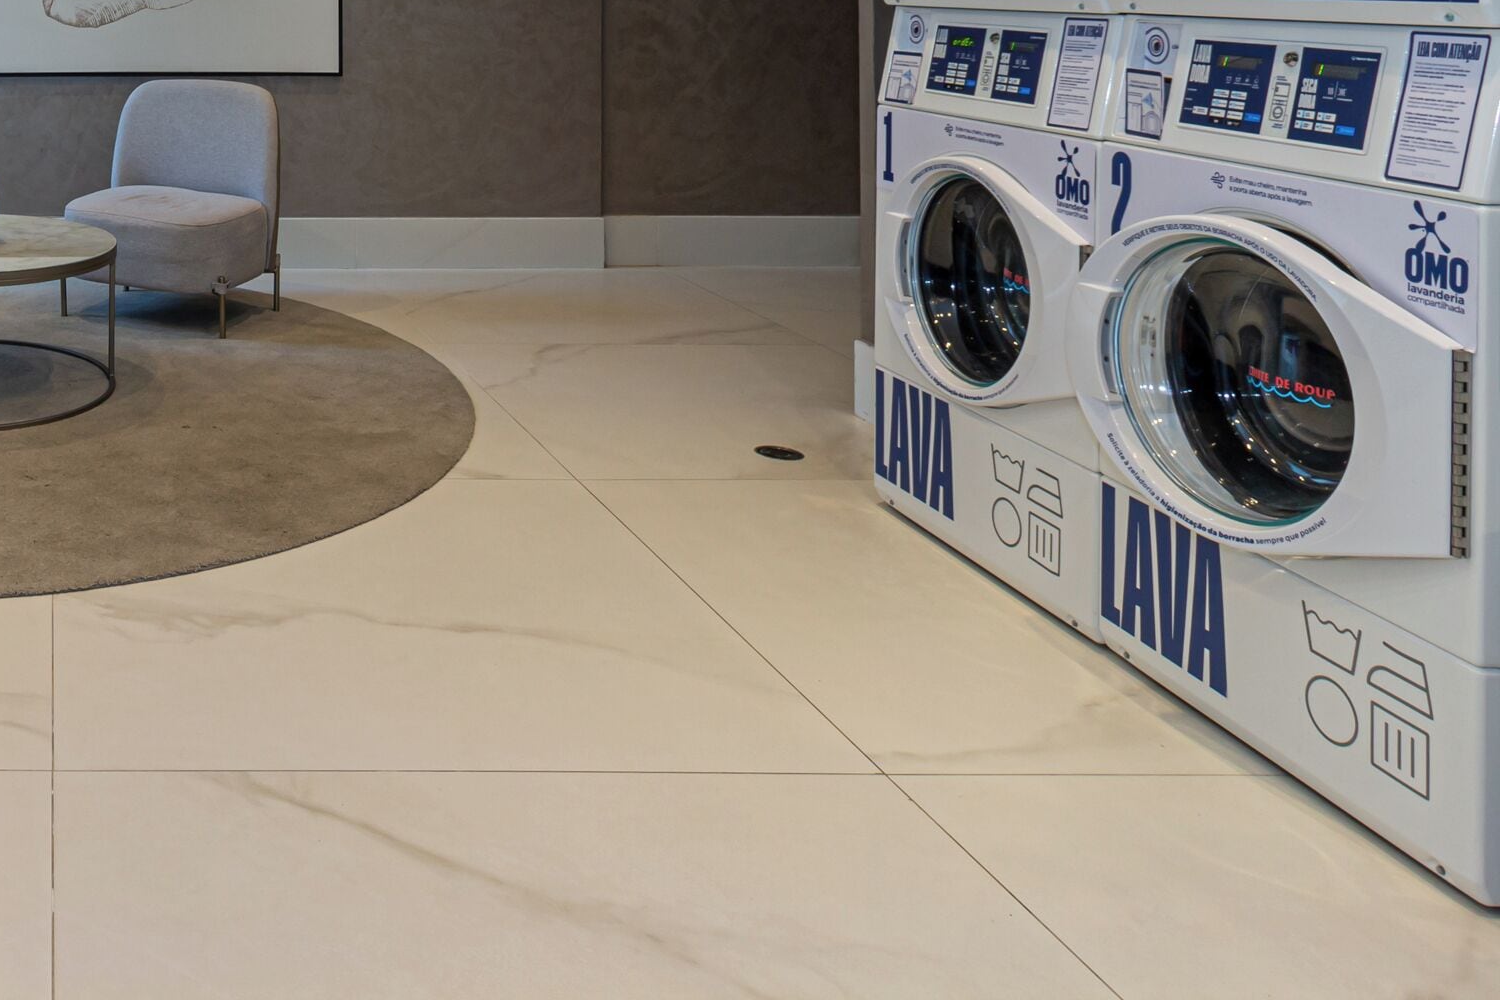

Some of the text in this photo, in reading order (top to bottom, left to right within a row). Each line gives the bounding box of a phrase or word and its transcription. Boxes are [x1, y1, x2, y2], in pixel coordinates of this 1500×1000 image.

[883, 112, 894, 182] 1
[1055, 174, 1090, 205] OMO
[1111, 151, 1132, 236] 2
[1405, 248, 1469, 294] OMO
[1407, 282, 1465, 305] lavanderia
[1407, 294, 1465, 315] compartilhada
[1275, 376, 1290, 390] DE
[875, 368, 954, 522] LAVA
[1106, 432, 1127, 461] Solicite
[1127, 464, 1156, 496] zeladoria
[1159, 497, 1208, 533] higienização
[1207, 526, 1218, 537] da
[1218, 530, 1255, 545] borracha
[1255, 535, 1284, 545] sempre
[1284, 532, 1299, 543] que
[1299, 517, 1327, 539] possível
[1101, 481, 1228, 698] LAVA
